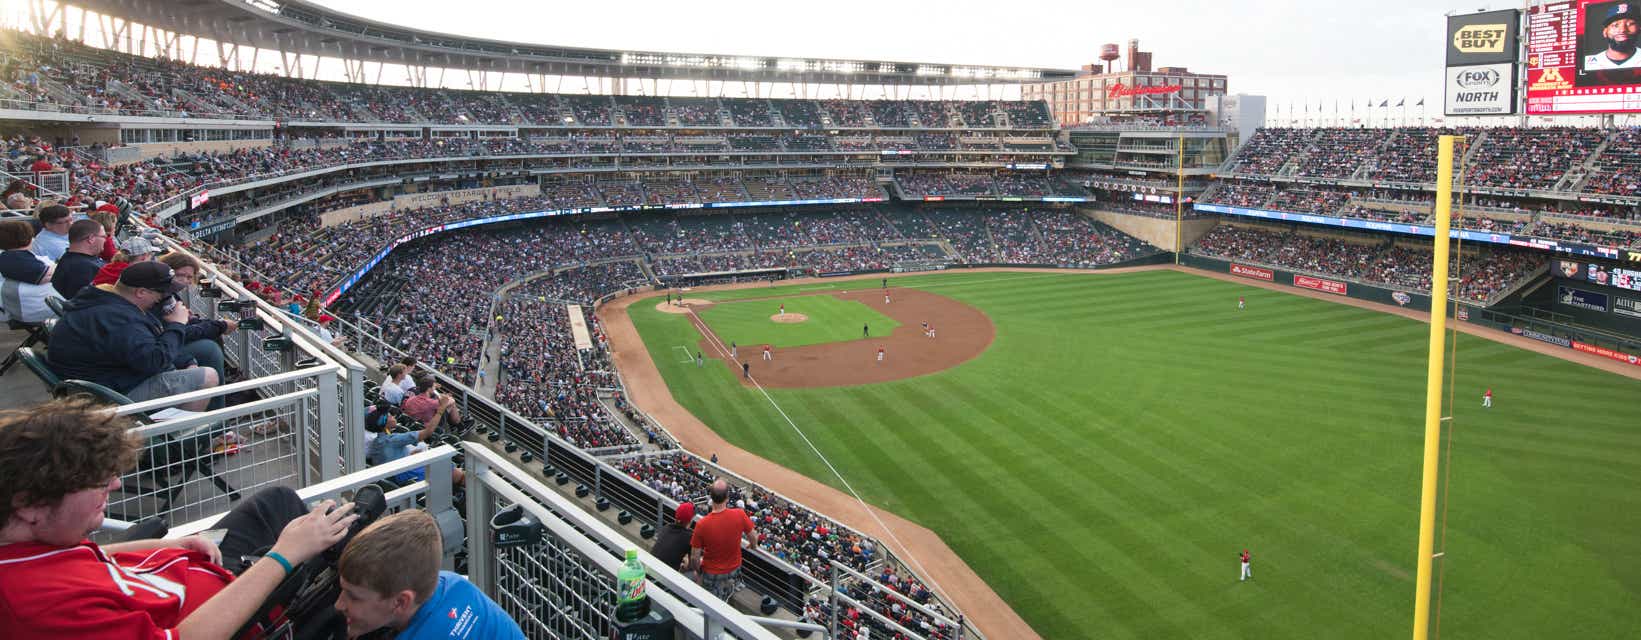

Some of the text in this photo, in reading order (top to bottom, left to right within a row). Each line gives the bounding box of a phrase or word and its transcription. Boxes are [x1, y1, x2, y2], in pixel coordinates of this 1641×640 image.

[1461, 30, 1504, 39] BEST
[1461, 39, 1499, 48] BUY
[1465, 71, 1490, 82] FOX
[1456, 92, 1499, 102] NORTH
[451, 190, 461, 198] TO
[196, 227, 212, 239] DELTA
